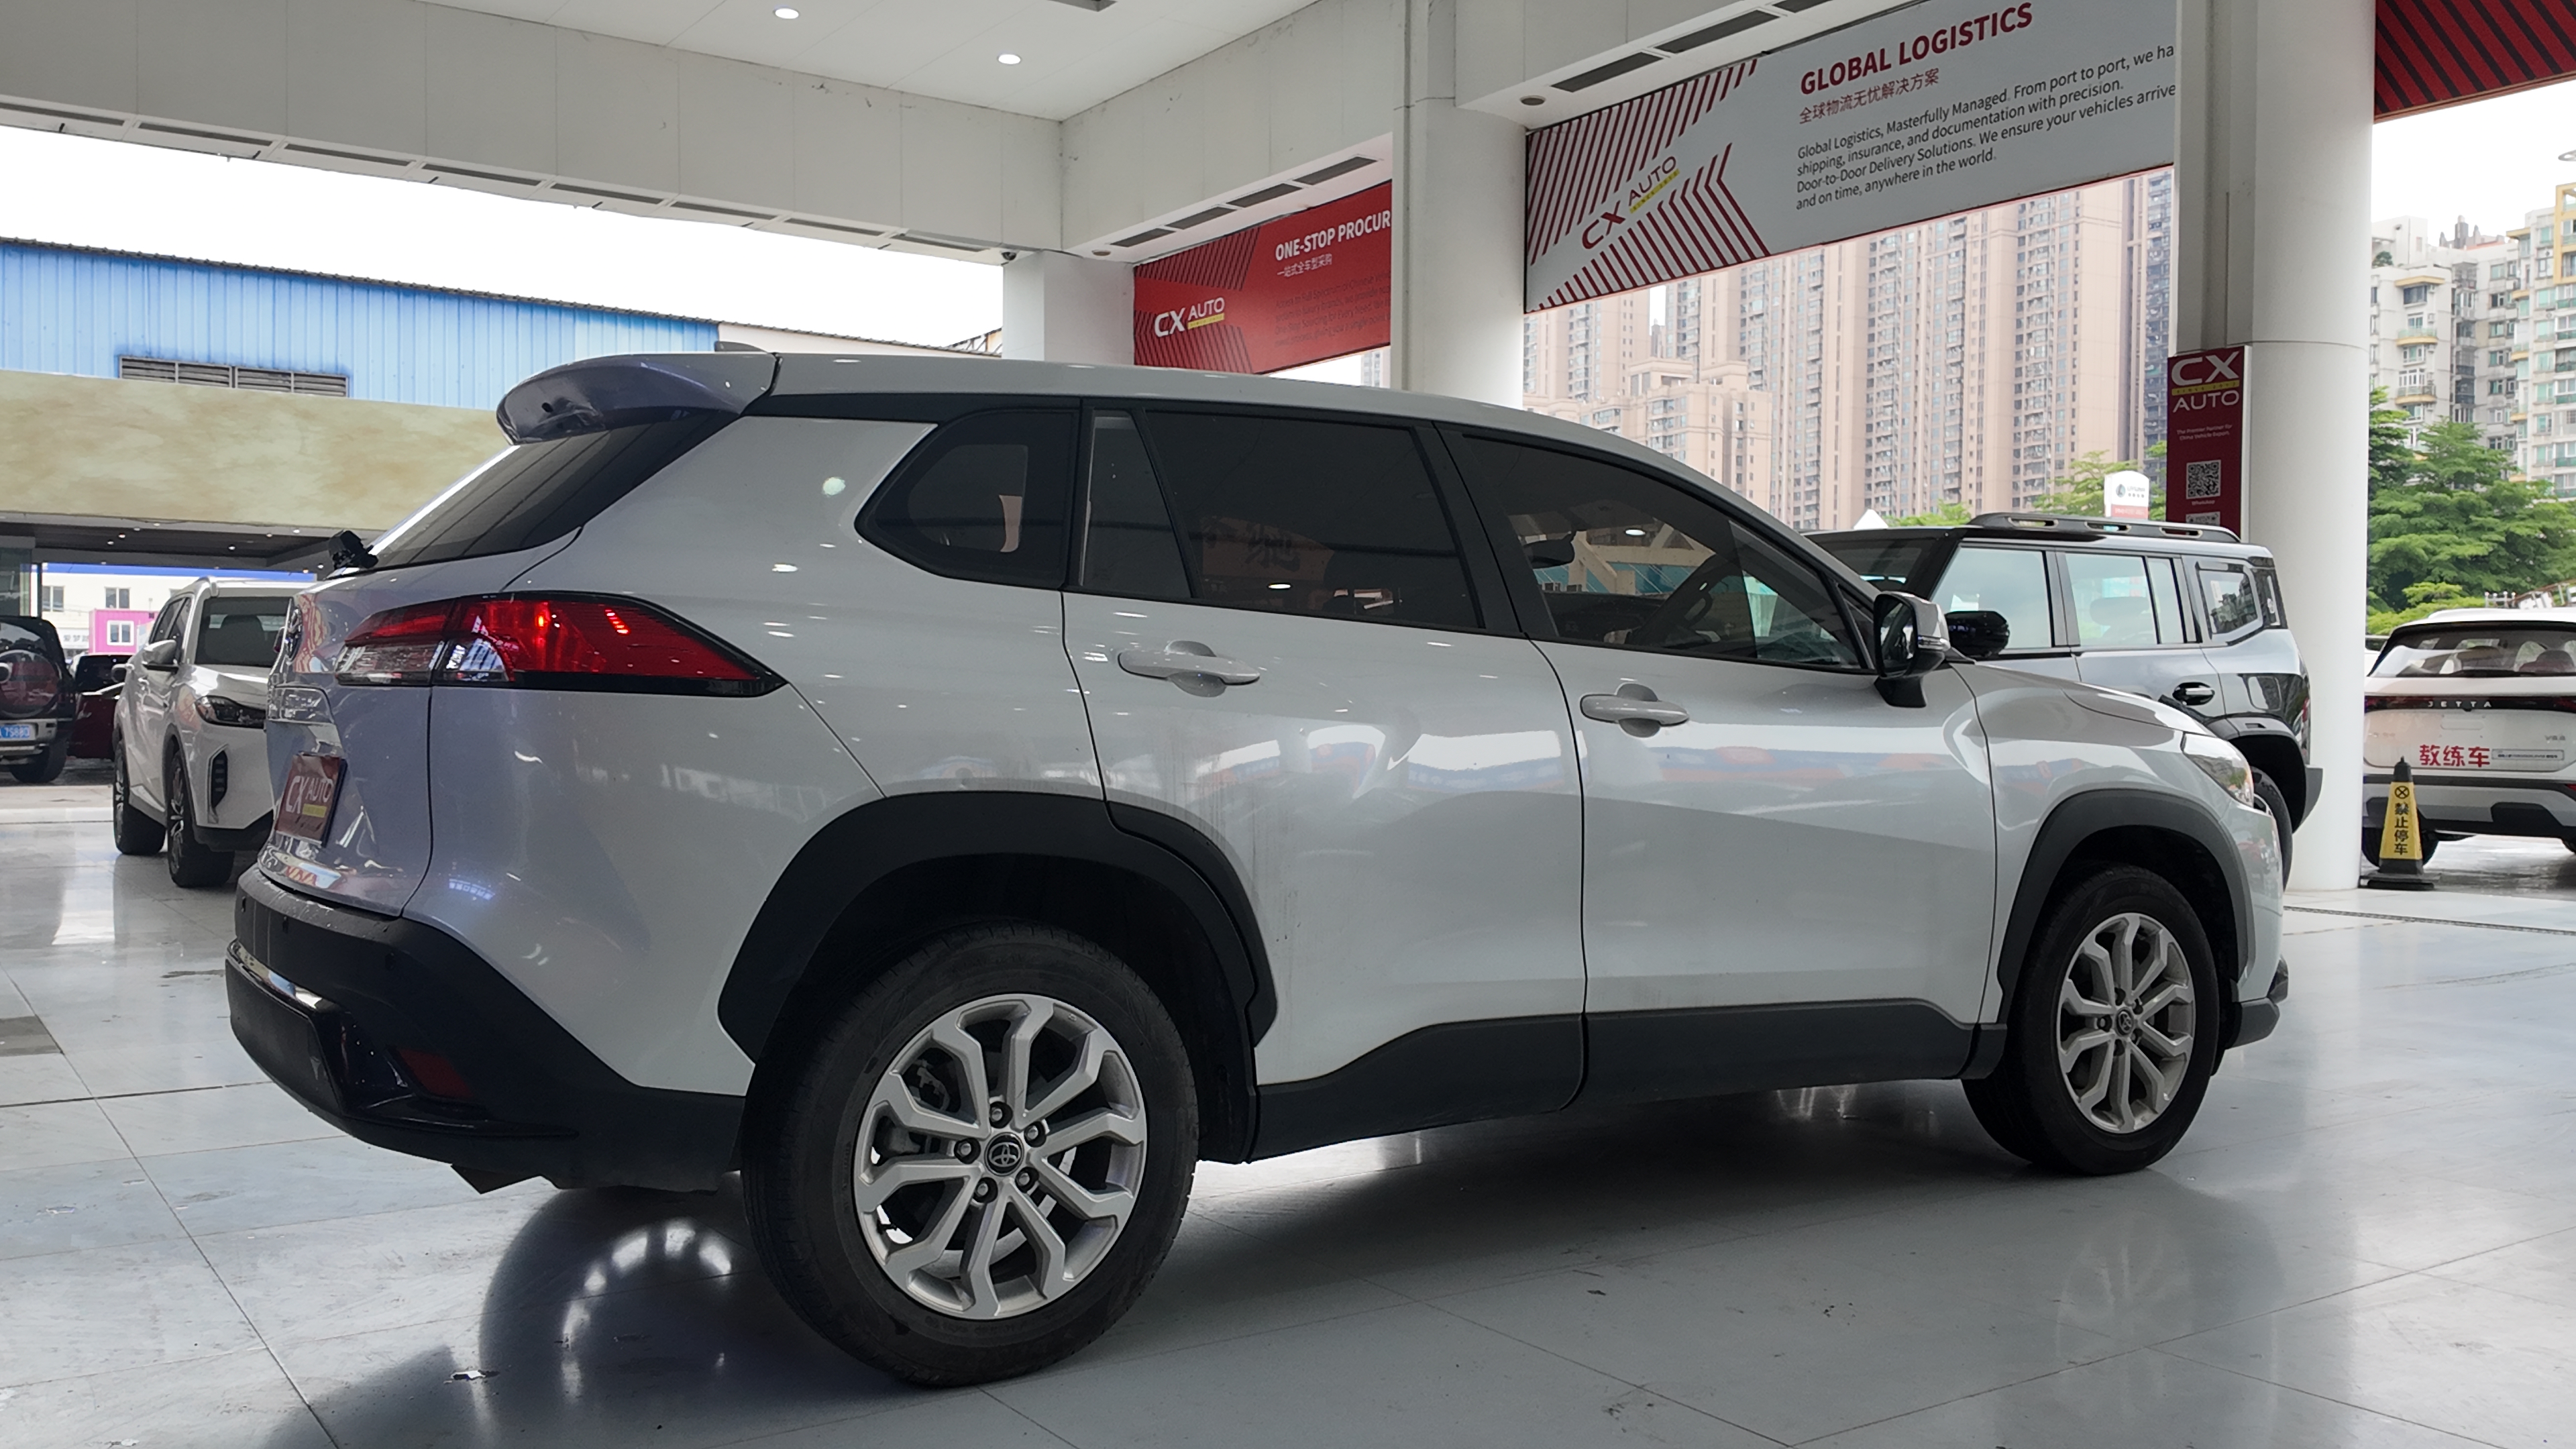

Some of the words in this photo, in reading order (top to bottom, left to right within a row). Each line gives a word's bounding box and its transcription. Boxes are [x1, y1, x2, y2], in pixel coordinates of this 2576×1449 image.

[1801, 48, 1892, 95] GLOBAL
[1899, 3, 2033, 65] LOGISTICS
[1797, 138, 1831, 160] Global
[1834, 127, 1884, 150] Logistics,
[1886, 106, 1950, 135] Masterfully
[2014, 80, 2047, 99] From
[2049, 70, 2078, 93] port
[2080, 67, 2094, 80] to
[2097, 56, 2130, 80] port,
[2133, 51, 2153, 66] we
[1799, 68, 1939, 124] 全球物流无忧解决方案
[1796, 155, 1846, 177] shipping,
[1847, 139, 1905, 162] insurance,
[1907, 127, 1929, 147] and
[1931, 105, 2025, 140] documentation
[2027, 94, 2056, 114] with
[2059, 79, 2124, 109] precision.
[1796, 165, 1868, 193] Door-to-Door
[1869, 153, 1915, 174] Delivery
[1978, 130, 1998, 145] We
[2000, 119, 2044, 140] ensure
[2046, 110, 2077, 131] your
[2078, 95, 2134, 119] vehicles
[2136, 85, 2176, 105] arrive
[1582, 200, 1626, 250] CX
[1628, 156, 1676, 207] AUTO
[1796, 193, 1817, 211] and
[1818, 192, 1833, 205] on
[1834, 185, 1863, 201] time,
[1864, 169, 1920, 193] anywhere
[1922, 164, 1933, 178] in
[1936, 160, 1956, 174] the
[1275, 228, 1336, 261] ONE-STOP
[1338, 210, 1391, 242] PROCUR
[1155, 307, 1185, 337] CX
[1187, 297, 1225, 321] AUTO
[2171, 351, 2240, 386] CX
[2173, 390, 2240, 413] AUTO
[2419, 744, 2491, 768] 教练车
[285, 775, 307, 814] CX
[305, 776, 334, 803] AUTO
[2394, 802, 2409, 856] 禁止停车
